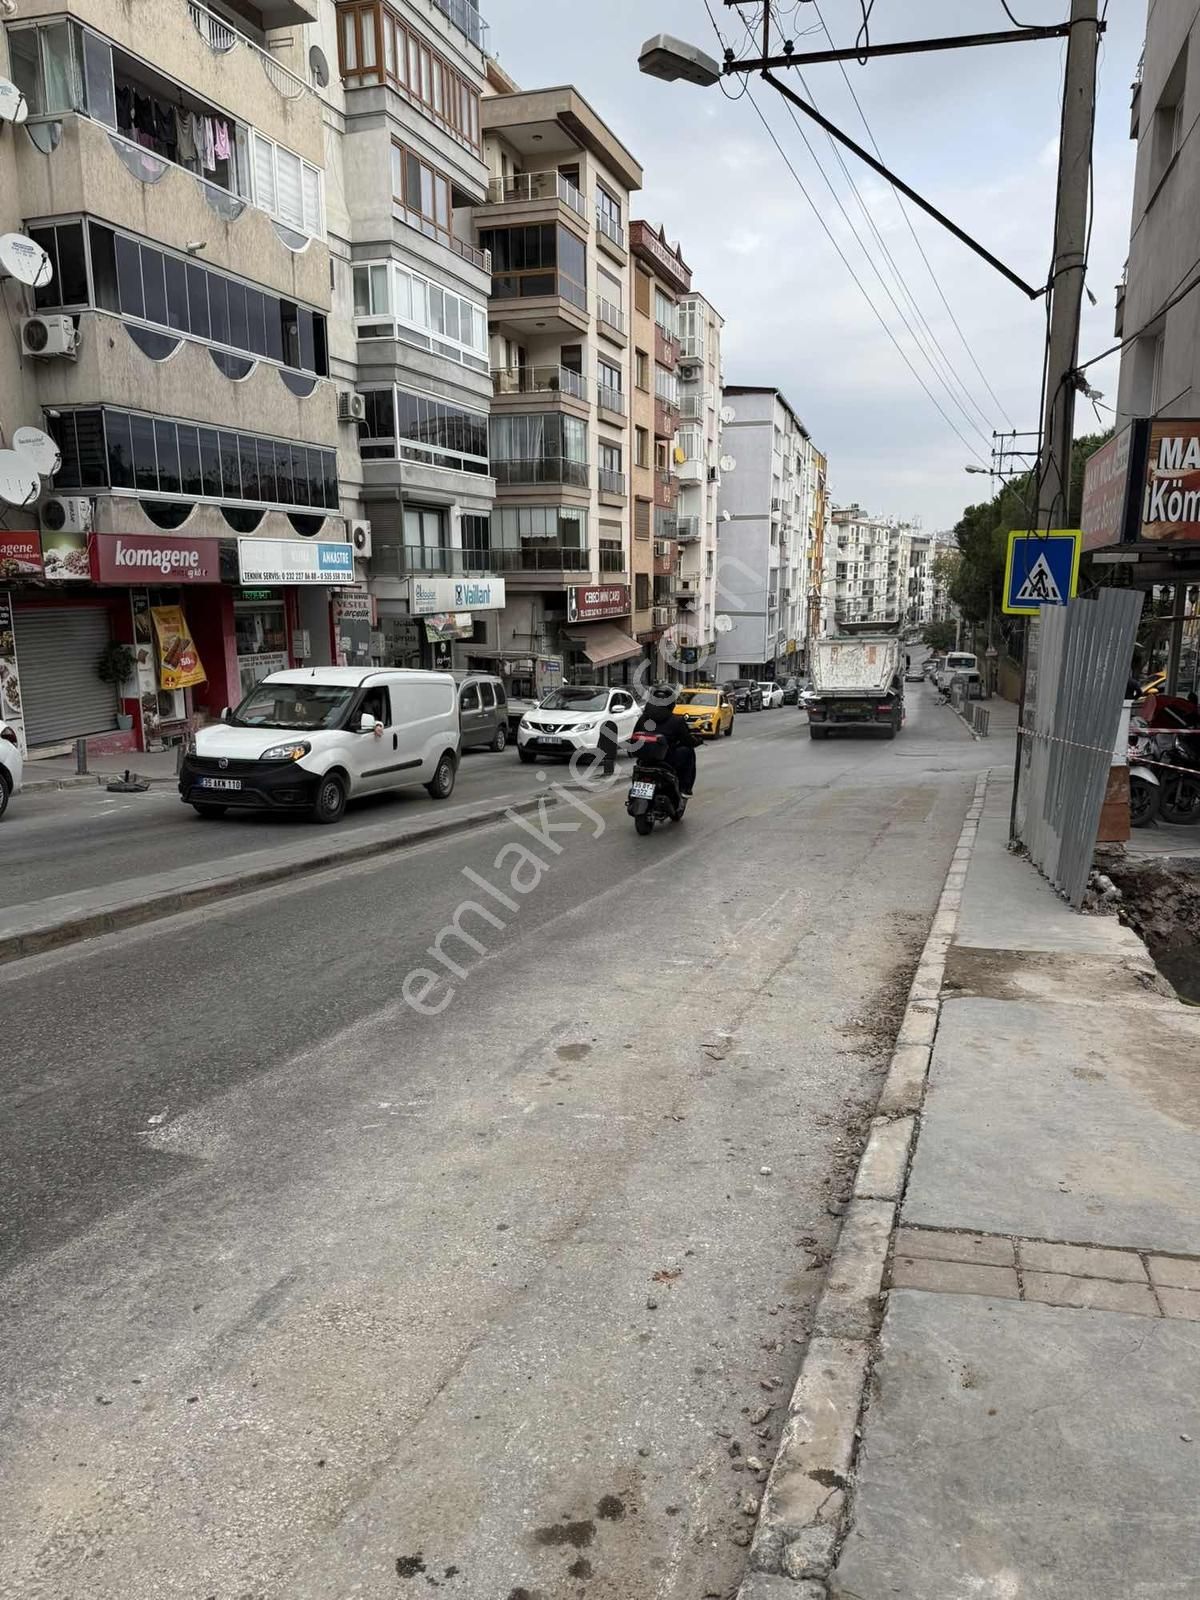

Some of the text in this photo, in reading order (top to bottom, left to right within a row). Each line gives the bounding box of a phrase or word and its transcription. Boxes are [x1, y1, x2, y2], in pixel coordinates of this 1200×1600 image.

[115, 540, 199, 574] komagene
[463, 583, 491, 605] Vaillant
[336, 601, 368, 609] VESTEL
[344, 609, 369, 618] arçelik
